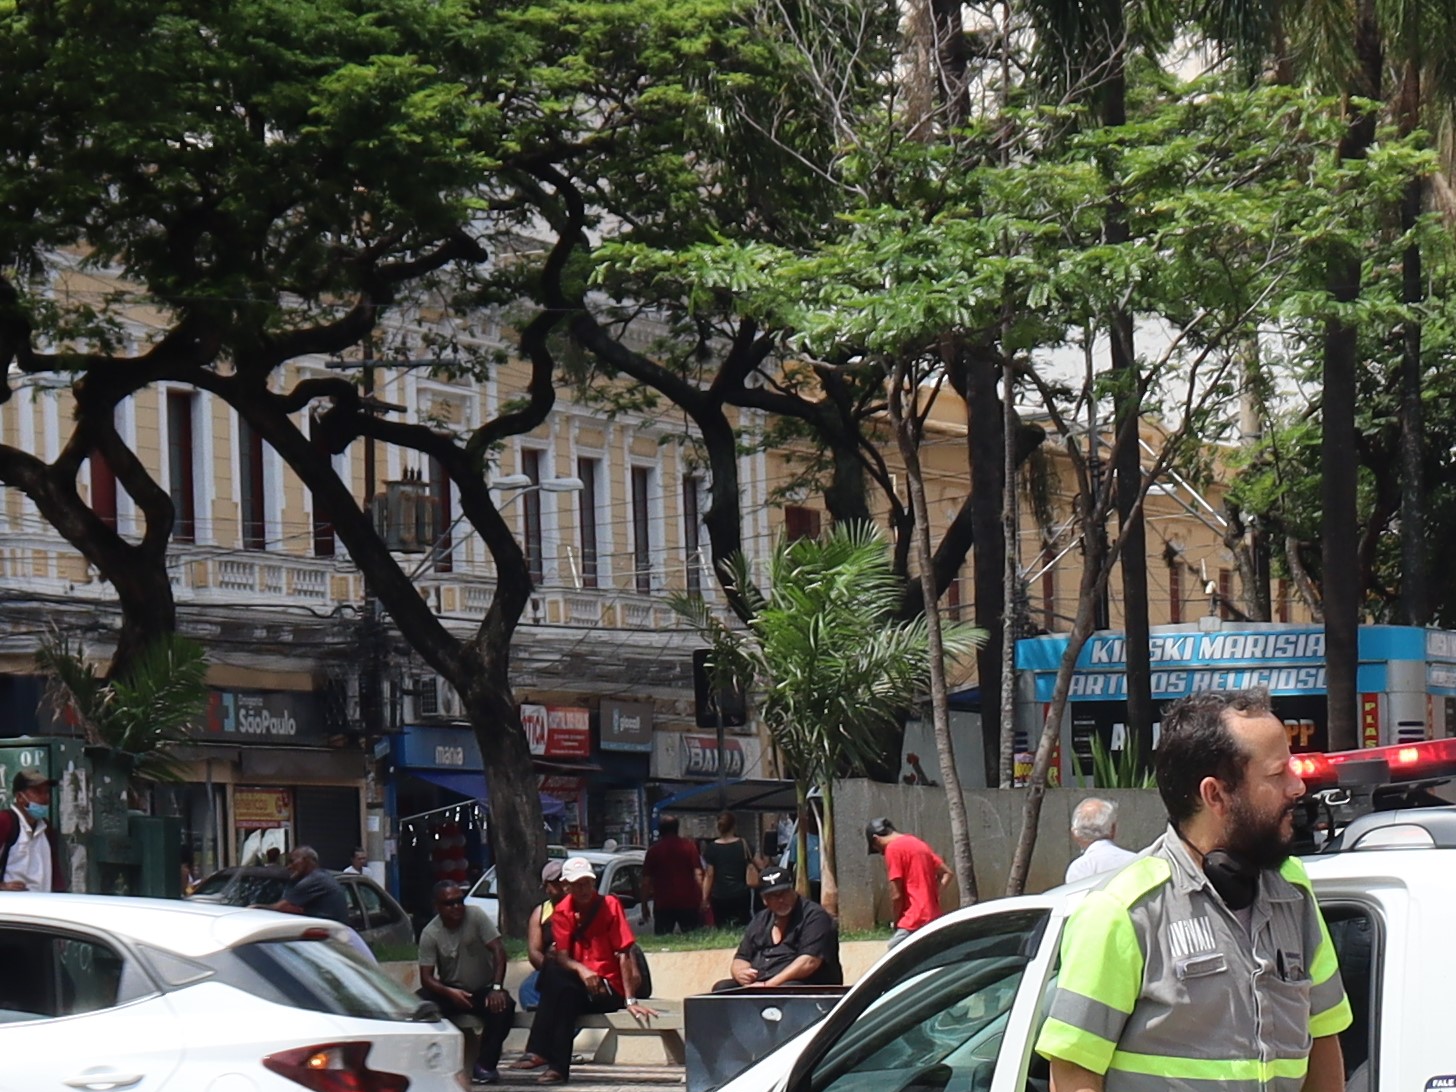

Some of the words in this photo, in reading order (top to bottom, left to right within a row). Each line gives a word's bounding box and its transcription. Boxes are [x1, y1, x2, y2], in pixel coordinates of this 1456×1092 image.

[1090, 637, 1194, 664] KISKI
[1067, 671, 1187, 696] ARTIOS
[1432, 1078, 1456, 1087] FALE
